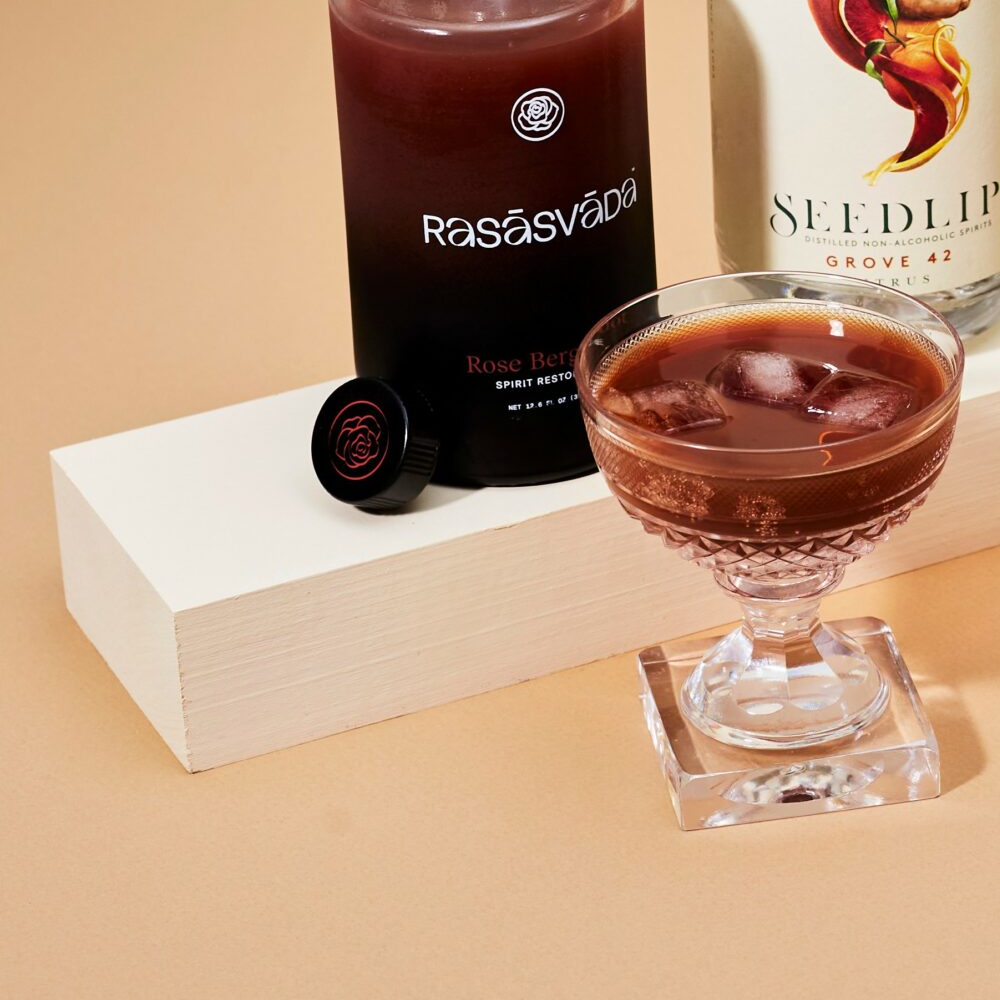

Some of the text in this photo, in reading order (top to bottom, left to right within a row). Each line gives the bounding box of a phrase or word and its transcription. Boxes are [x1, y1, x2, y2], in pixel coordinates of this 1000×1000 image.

[804, 218, 993, 248] DISTILLED NON-ALCOHOLIC SPIRITS
[825, 249, 952, 269] GROVE 42
[873, 274, 931, 288] TRUS
[466, 347, 579, 374] Rose Berg
[495, 370, 577, 391] SPIRIT RESTO
[507, 403, 522, 411] NET
